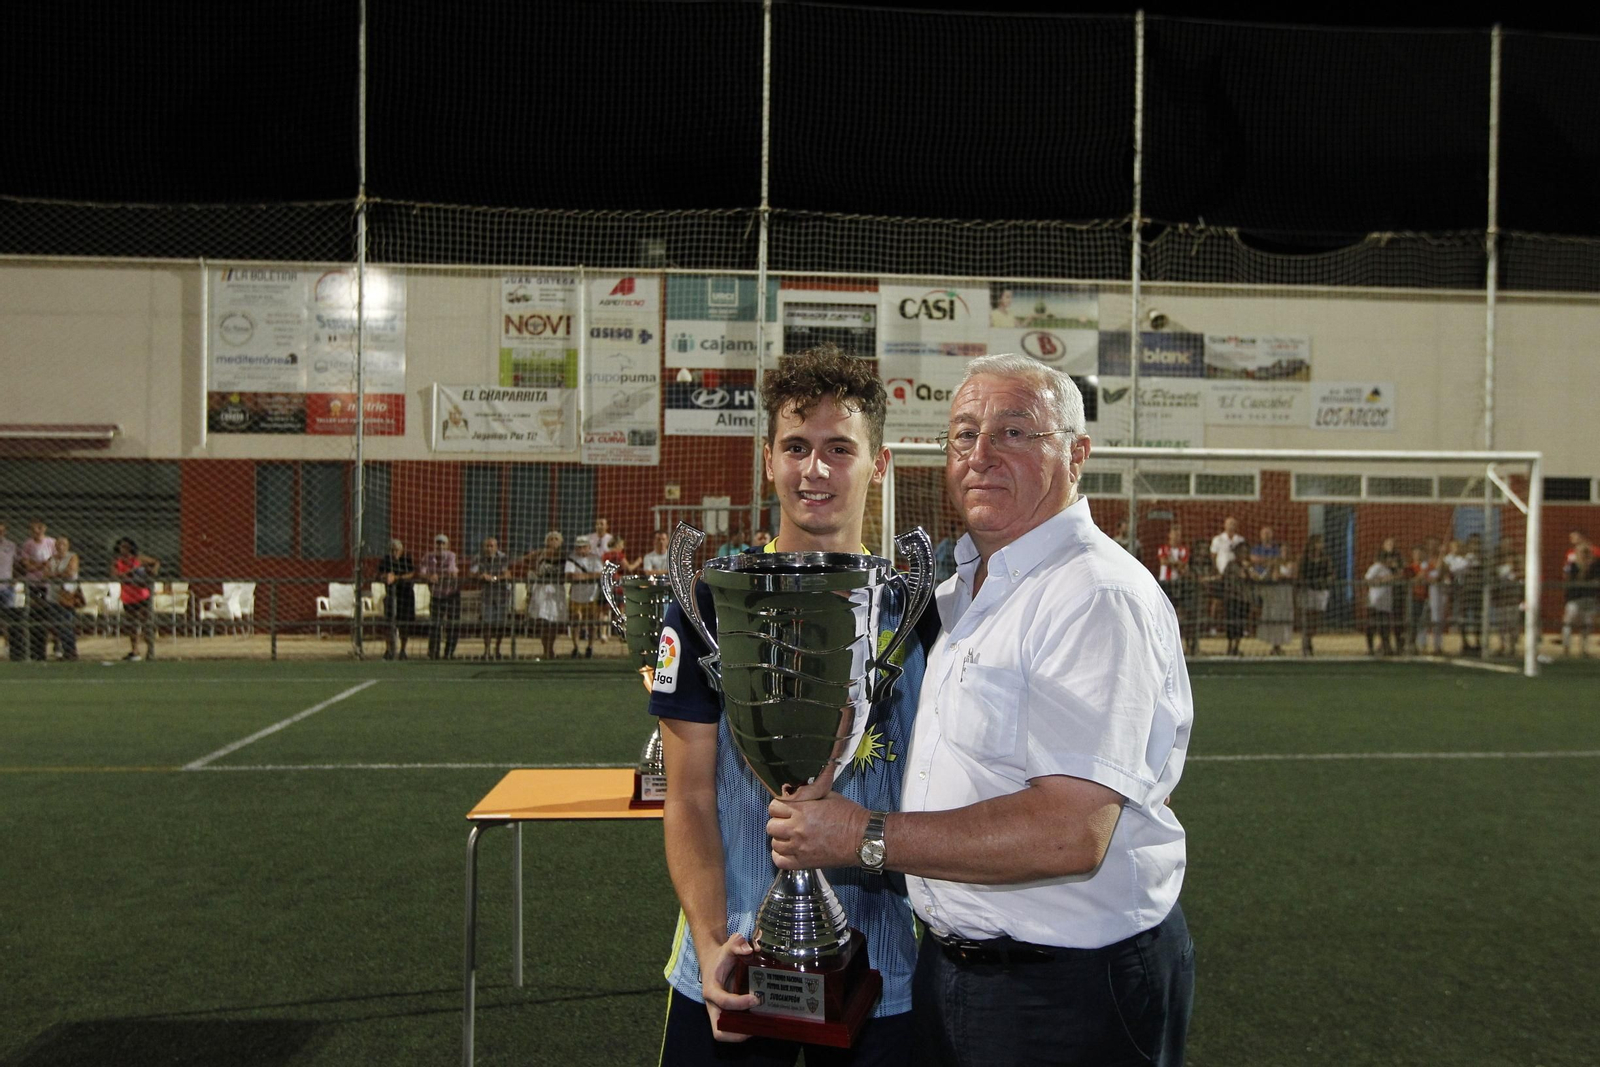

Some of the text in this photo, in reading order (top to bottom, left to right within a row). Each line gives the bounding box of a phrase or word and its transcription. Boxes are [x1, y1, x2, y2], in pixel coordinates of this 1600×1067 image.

[900, 298, 955, 320] CASI
[505, 314, 571, 335] NOVI
[700, 335, 774, 354] cajamr
[585, 373, 656, 384] grupopuma
[463, 390, 548, 402] EL CHAPARRITA
[654, 672, 673, 684] iga
